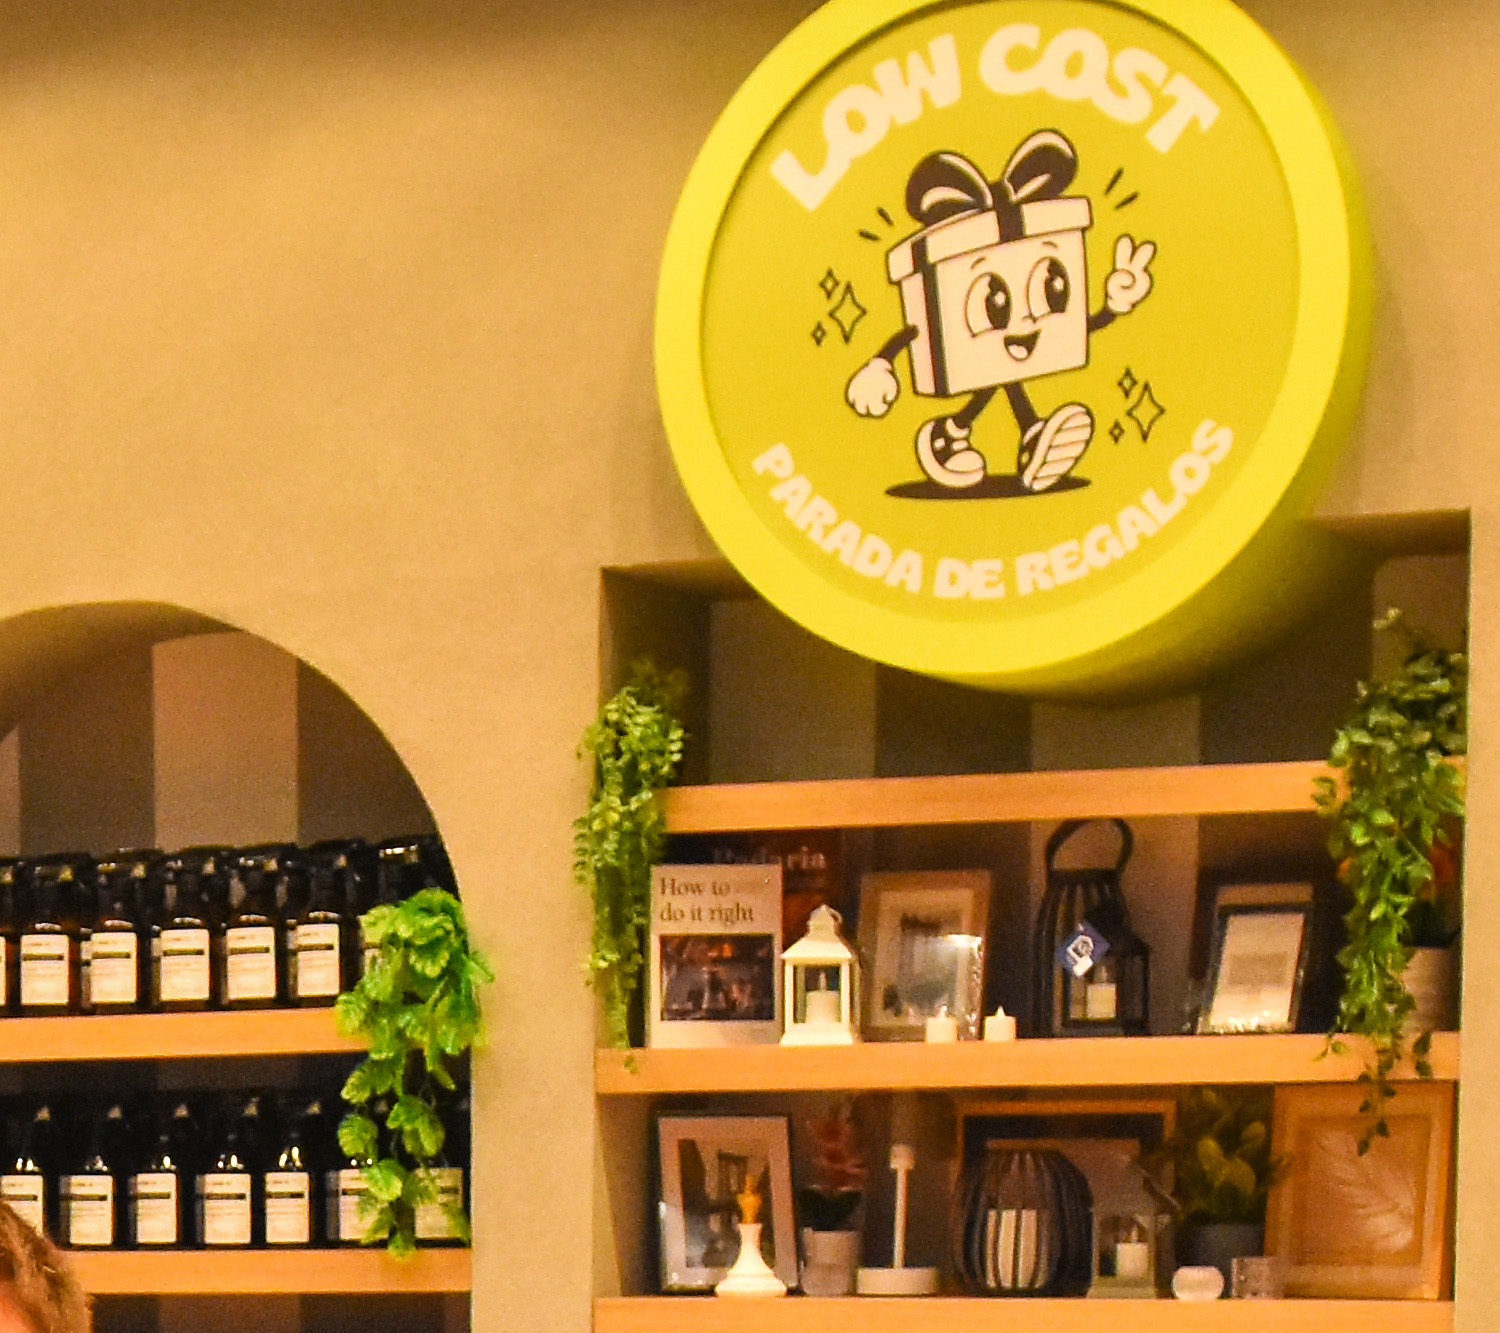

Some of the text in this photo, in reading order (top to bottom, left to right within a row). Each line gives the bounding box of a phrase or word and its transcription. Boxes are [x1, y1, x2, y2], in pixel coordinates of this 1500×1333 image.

[770, 22, 1221, 212] LOW COST
[752, 417, 1235, 599] PARADA DE REGALOS
[660, 877, 731, 896] How to
[660, 903, 755, 926] do it right
